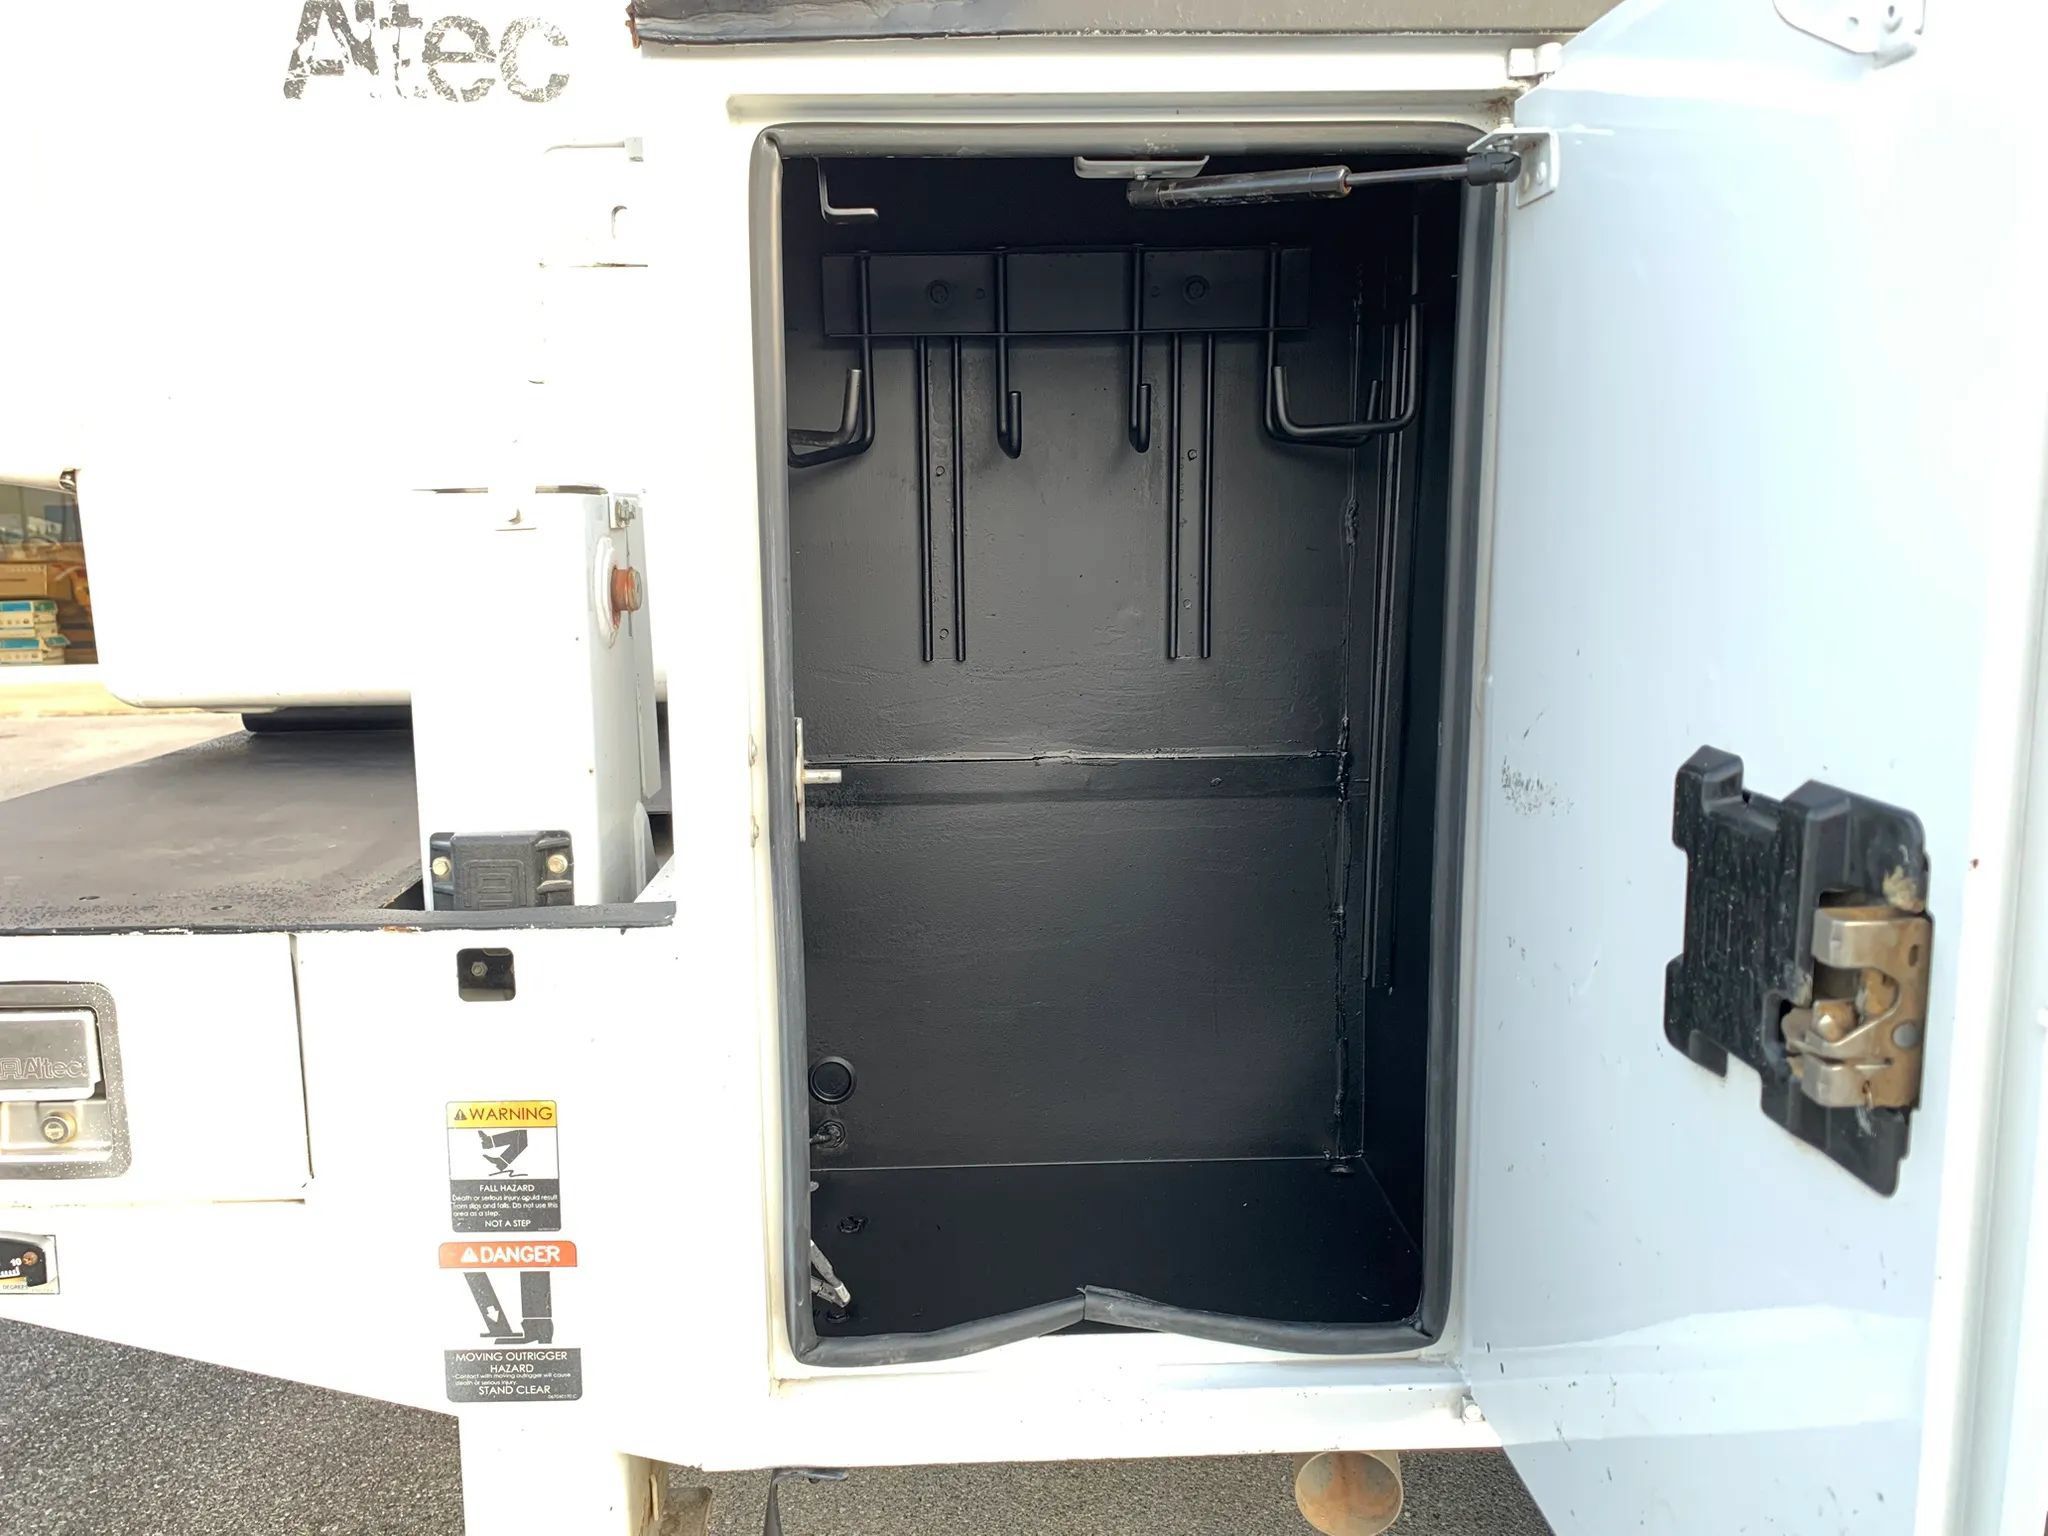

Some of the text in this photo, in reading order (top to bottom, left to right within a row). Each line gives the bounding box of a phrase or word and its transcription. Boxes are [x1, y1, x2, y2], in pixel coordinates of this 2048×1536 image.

[469, 1106, 553, 1121] WARNING
[479, 1184, 535, 1192] FALL HAZARD
[503, 1194, 520, 1203] injury
[484, 1219, 532, 1228] NOT A STEP
[480, 1245, 561, 1263] DANGER
[9, 1257, 22, 1267] 10
[455, 1351, 568, 1362] MOVING OUTRIGGER
[490, 1364, 535, 1373] HAZARD
[478, 1385, 551, 1396] STAND CLEAR
